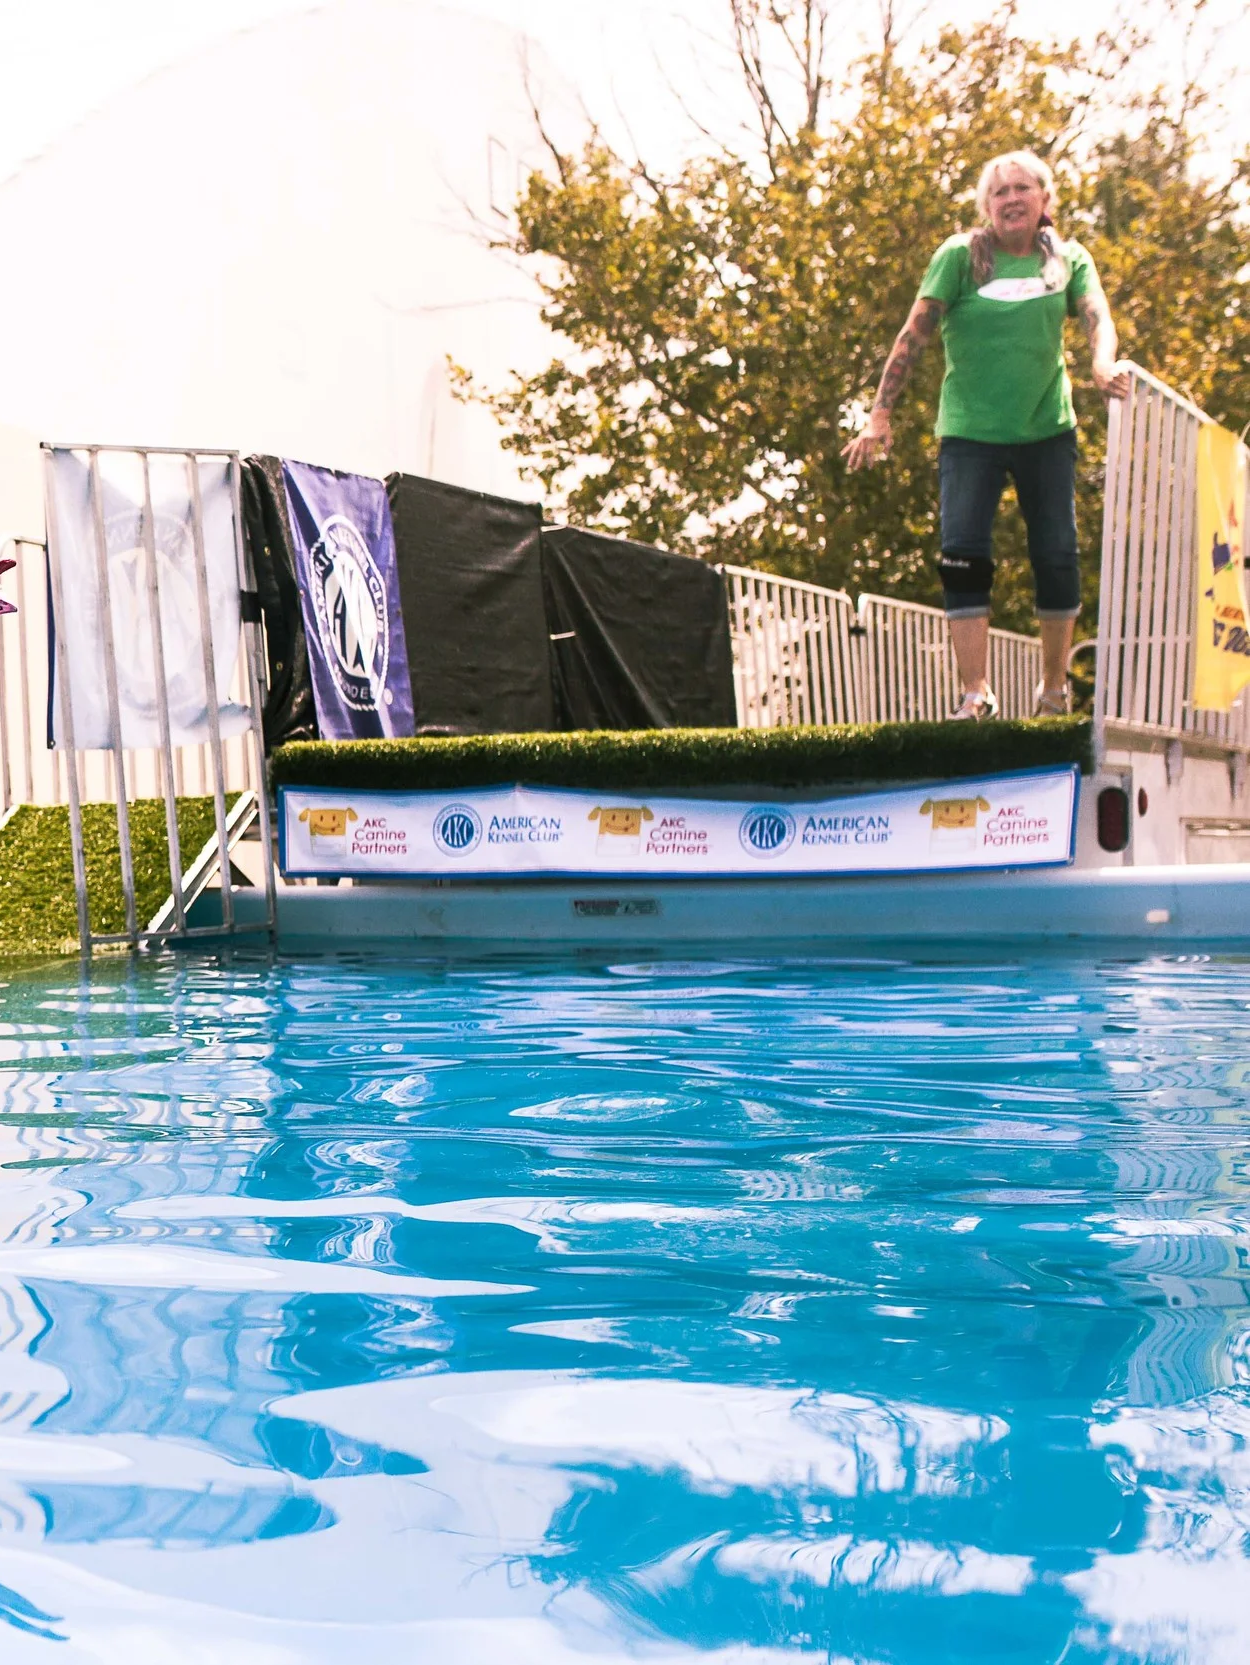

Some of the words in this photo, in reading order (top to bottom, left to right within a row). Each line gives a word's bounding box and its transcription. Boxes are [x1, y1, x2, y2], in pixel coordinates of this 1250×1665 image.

[998, 805, 1024, 817] AKC
[363, 818, 387, 828] AKC
[489, 815, 561, 831] AMERICAN
[660, 817, 686, 828] AKC
[803, 815, 889, 832] AMERICAN
[986, 817, 1048, 832] Canine
[354, 828, 406, 841] Canine
[442, 815, 474, 848] AKC
[487, 831, 524, 843] KENNEL
[650, 828, 707, 841] Canine
[749, 817, 786, 849] AKC
[802, 833, 848, 845] KENNEL
[854, 831, 888, 844] CLUB
[983, 833, 1049, 846] Partners
[352, 842, 407, 854] Partners
[646, 842, 708, 855] Partners
